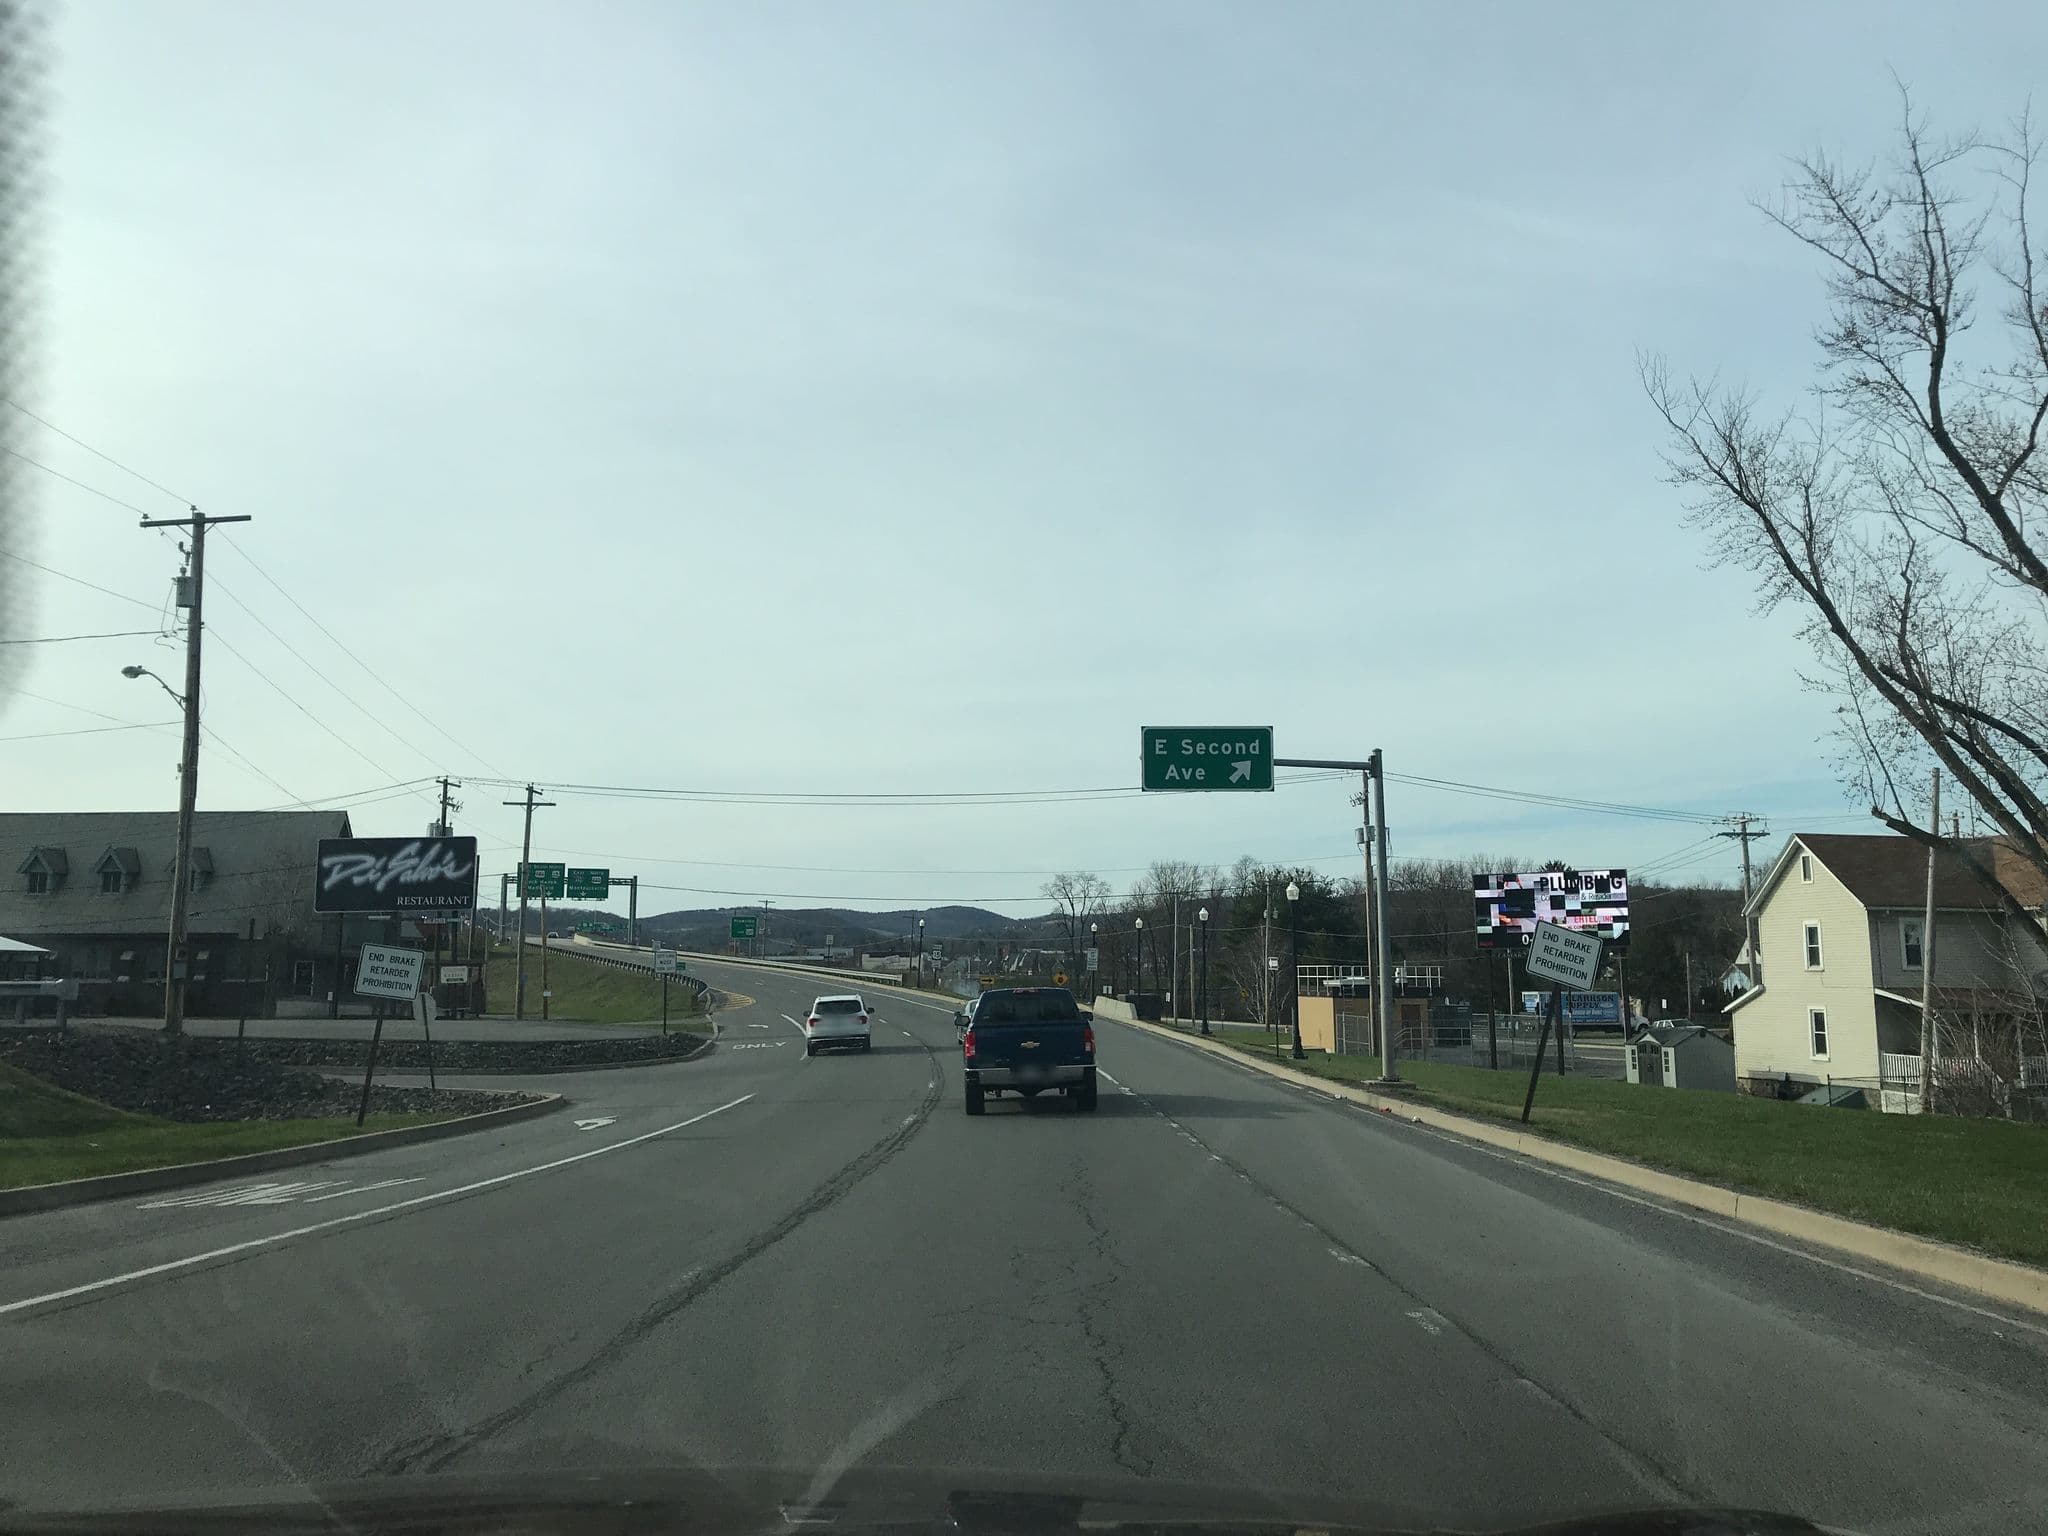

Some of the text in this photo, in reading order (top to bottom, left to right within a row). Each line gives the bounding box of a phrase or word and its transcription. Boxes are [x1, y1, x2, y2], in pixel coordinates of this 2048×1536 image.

[1155, 739, 1259, 755] E Second
[1165, 764, 1205, 780] Ave
[1540, 875, 1622, 891] PLUMBG
[397, 896, 470, 906] RESTAURANT
[1542, 931, 1593, 953] END BRAKE
[368, 953, 416, 967] END BRAKE
[1543, 945, 1585, 965] RETARDER
[370, 966, 410, 978] RETARDER
[1535, 956, 1587, 980] PROHIBITION
[362, 977, 413, 991] PROHIBITION
